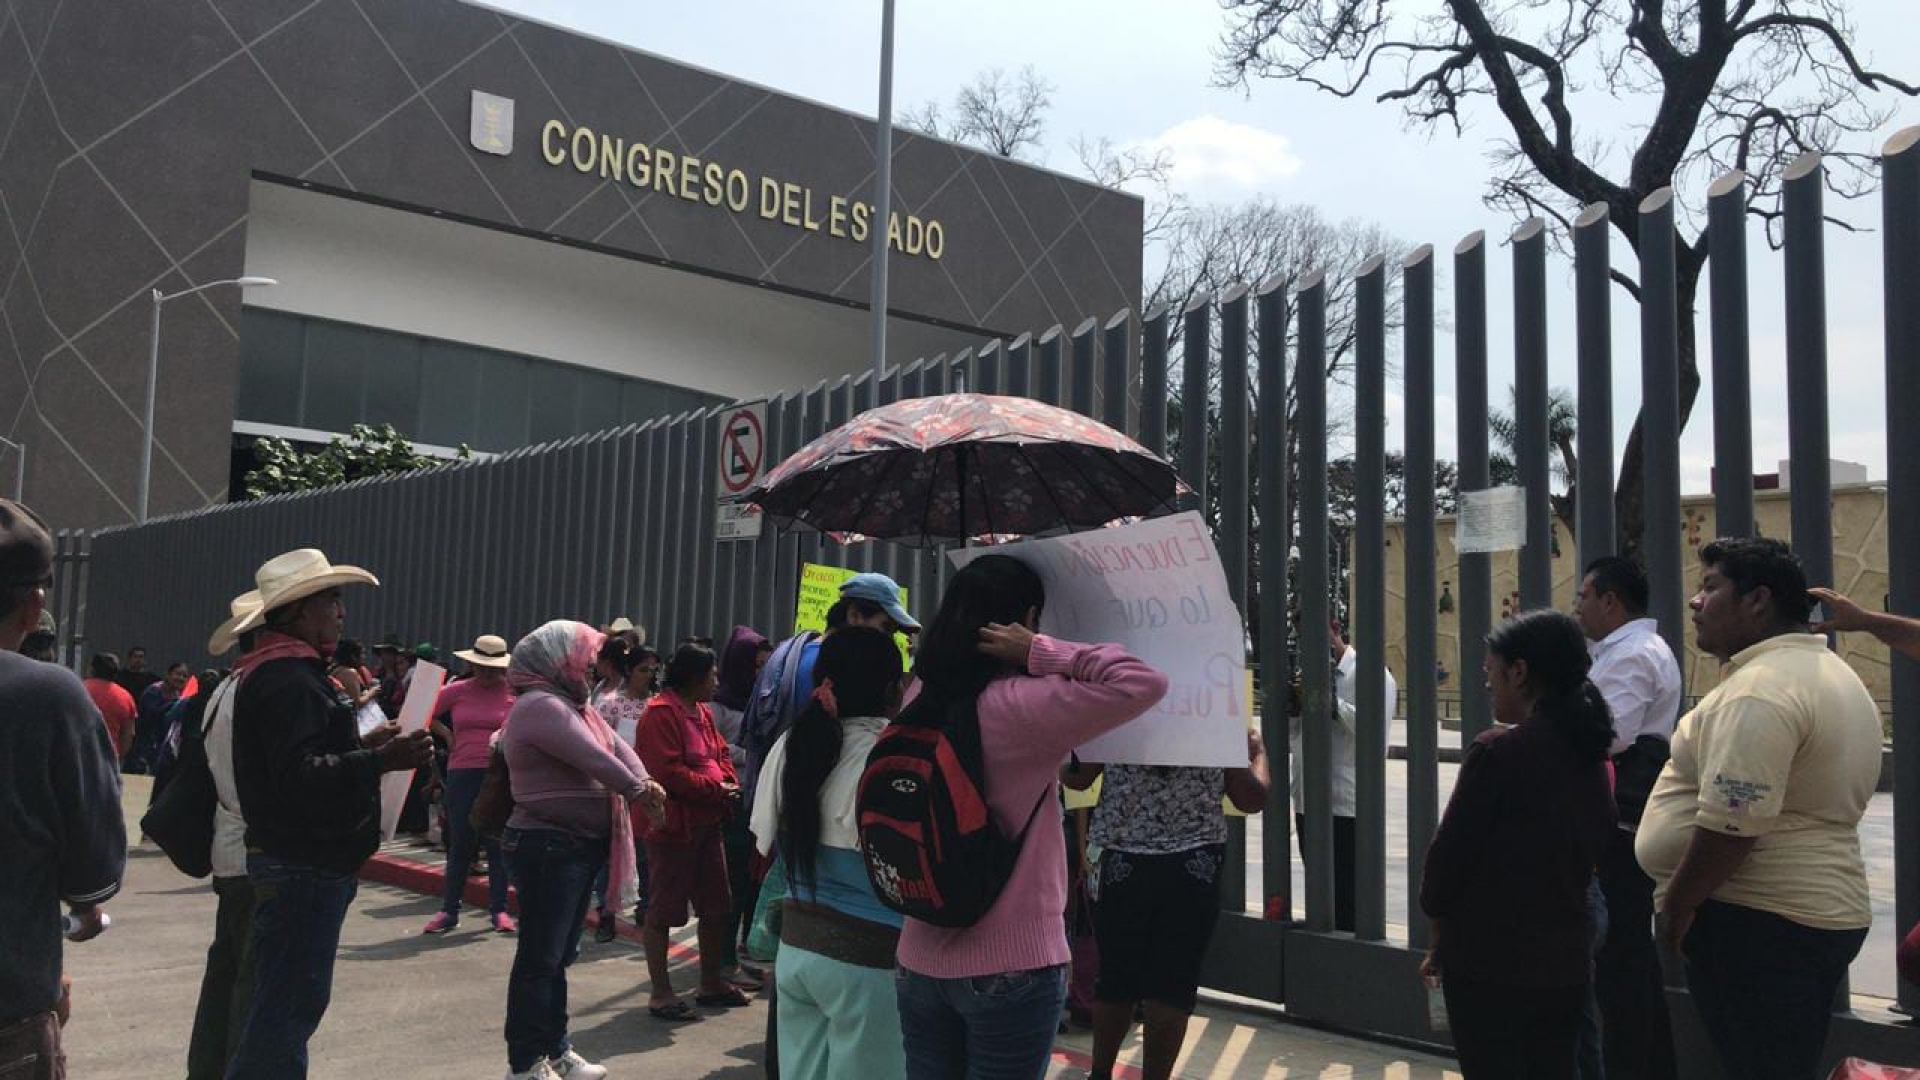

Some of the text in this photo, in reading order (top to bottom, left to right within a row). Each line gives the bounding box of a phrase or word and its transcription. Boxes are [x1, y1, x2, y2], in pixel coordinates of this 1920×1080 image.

[542, 119, 945, 259] CONGRESO DEL ESADO
